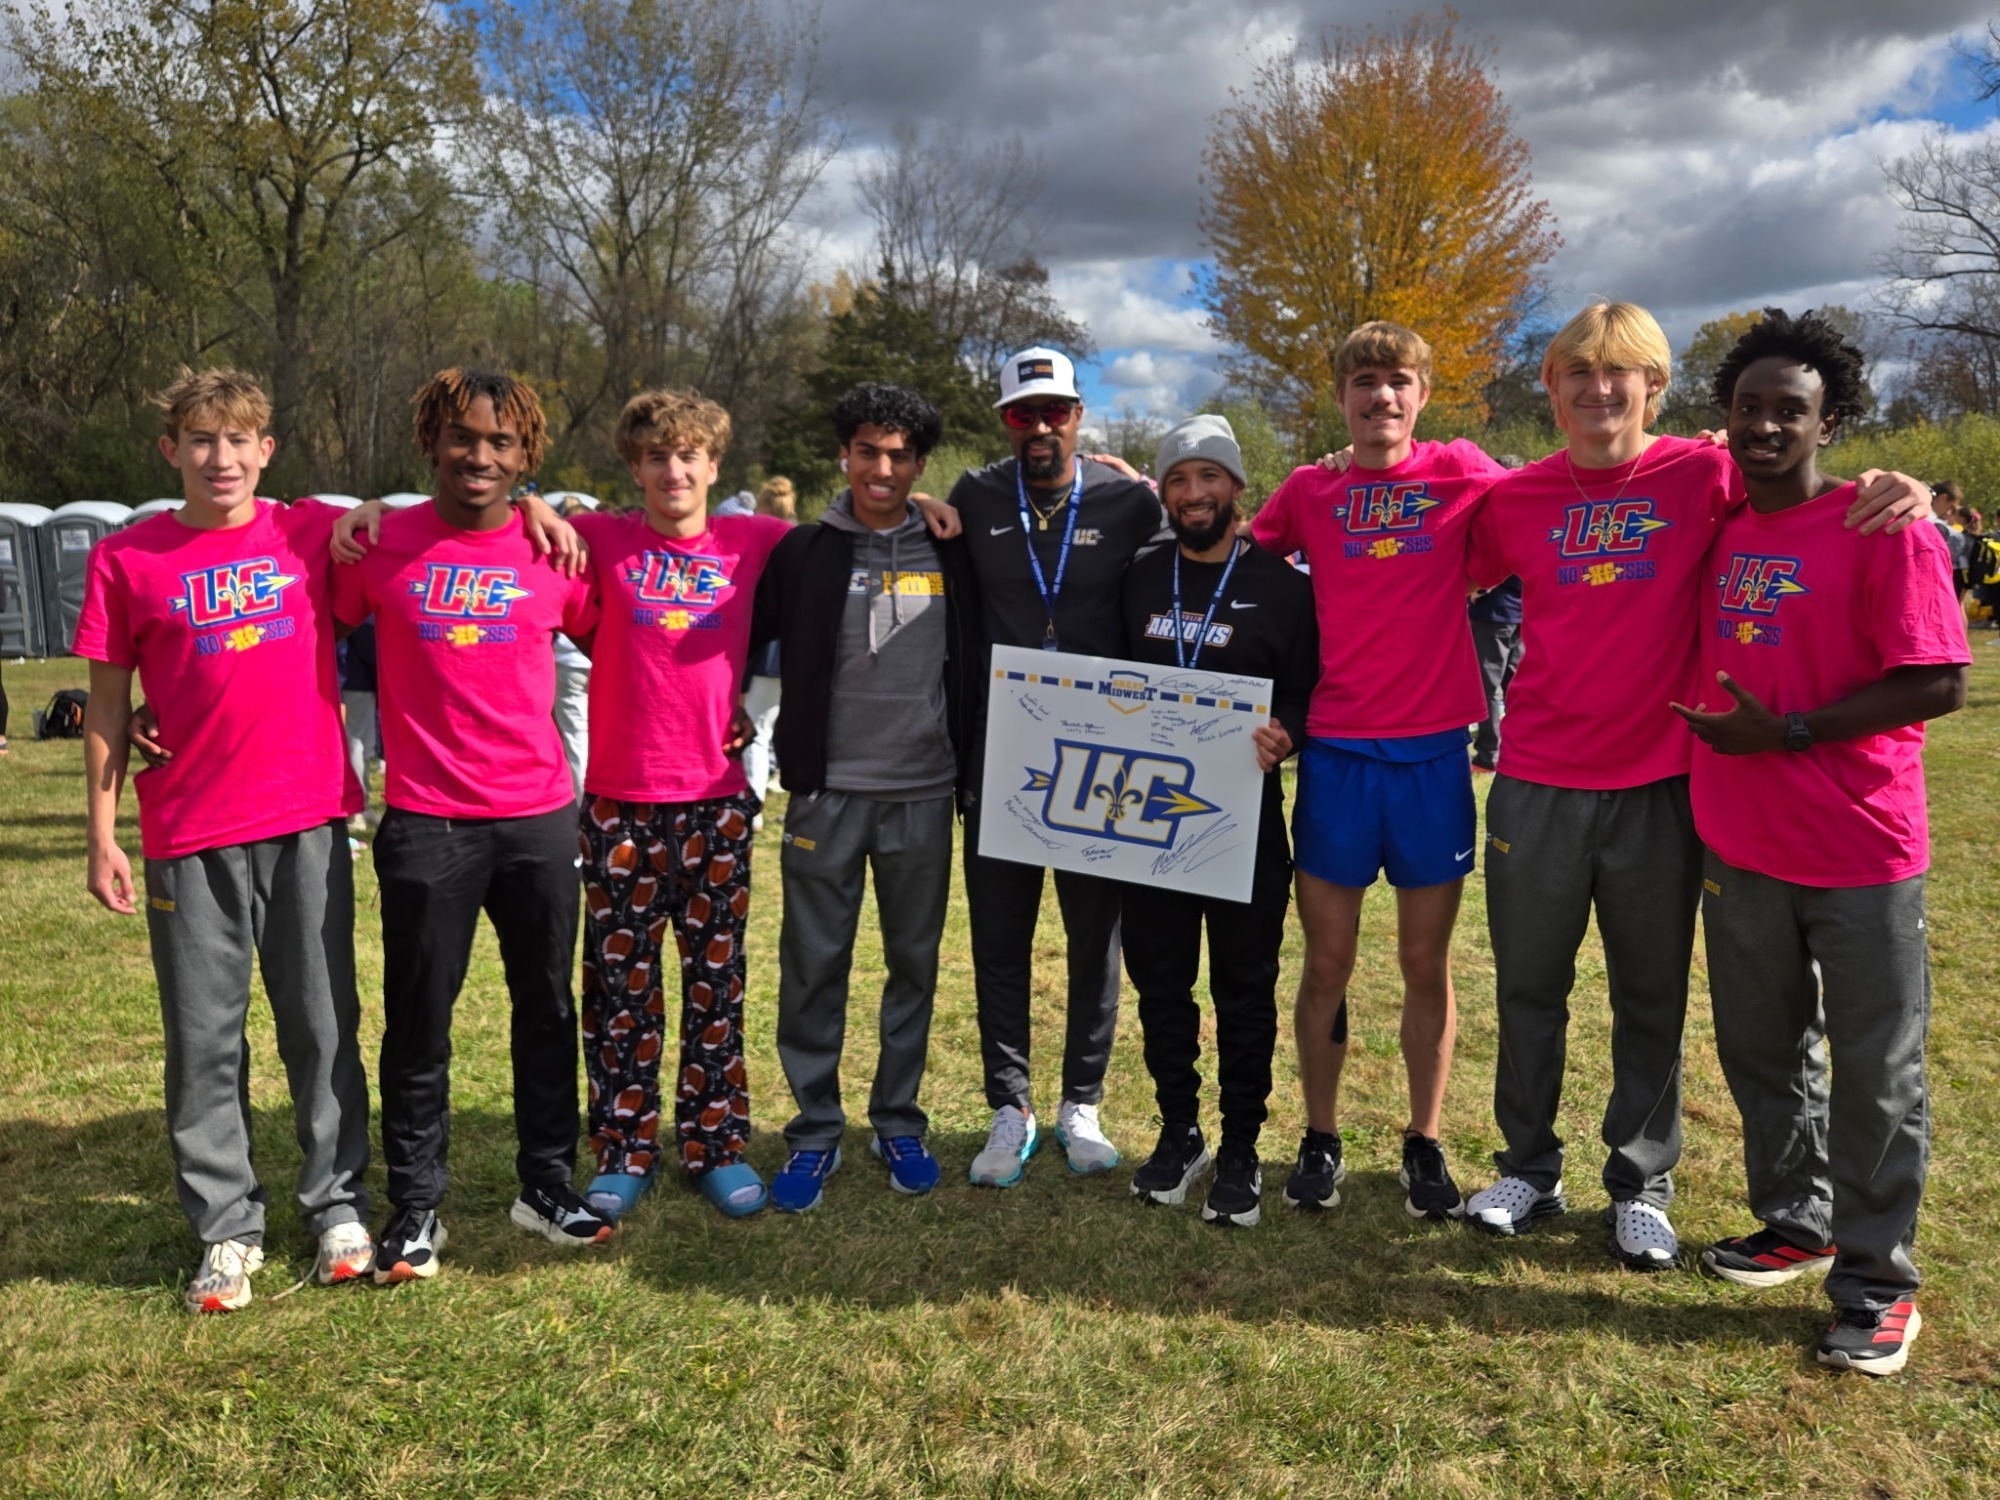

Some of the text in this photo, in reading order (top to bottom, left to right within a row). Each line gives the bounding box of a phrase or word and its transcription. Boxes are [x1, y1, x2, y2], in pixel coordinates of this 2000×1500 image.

[1346, 482, 1427, 534] UC
[1560, 498, 1655, 558] UC
[1344, 541, 1362, 558] NO
[1558, 566, 1578, 585] NO
[181, 557, 281, 629] UC
[423, 563, 517, 617] UC
[639, 551, 721, 605] UC
[1721, 553, 1801, 616] UC
[420, 622, 441, 640] NO
[634, 608, 654, 625] NO
[195, 634, 220, 656] NO
[1098, 680, 1157, 701] MIDWEST
[1044, 741, 1193, 847] UC
